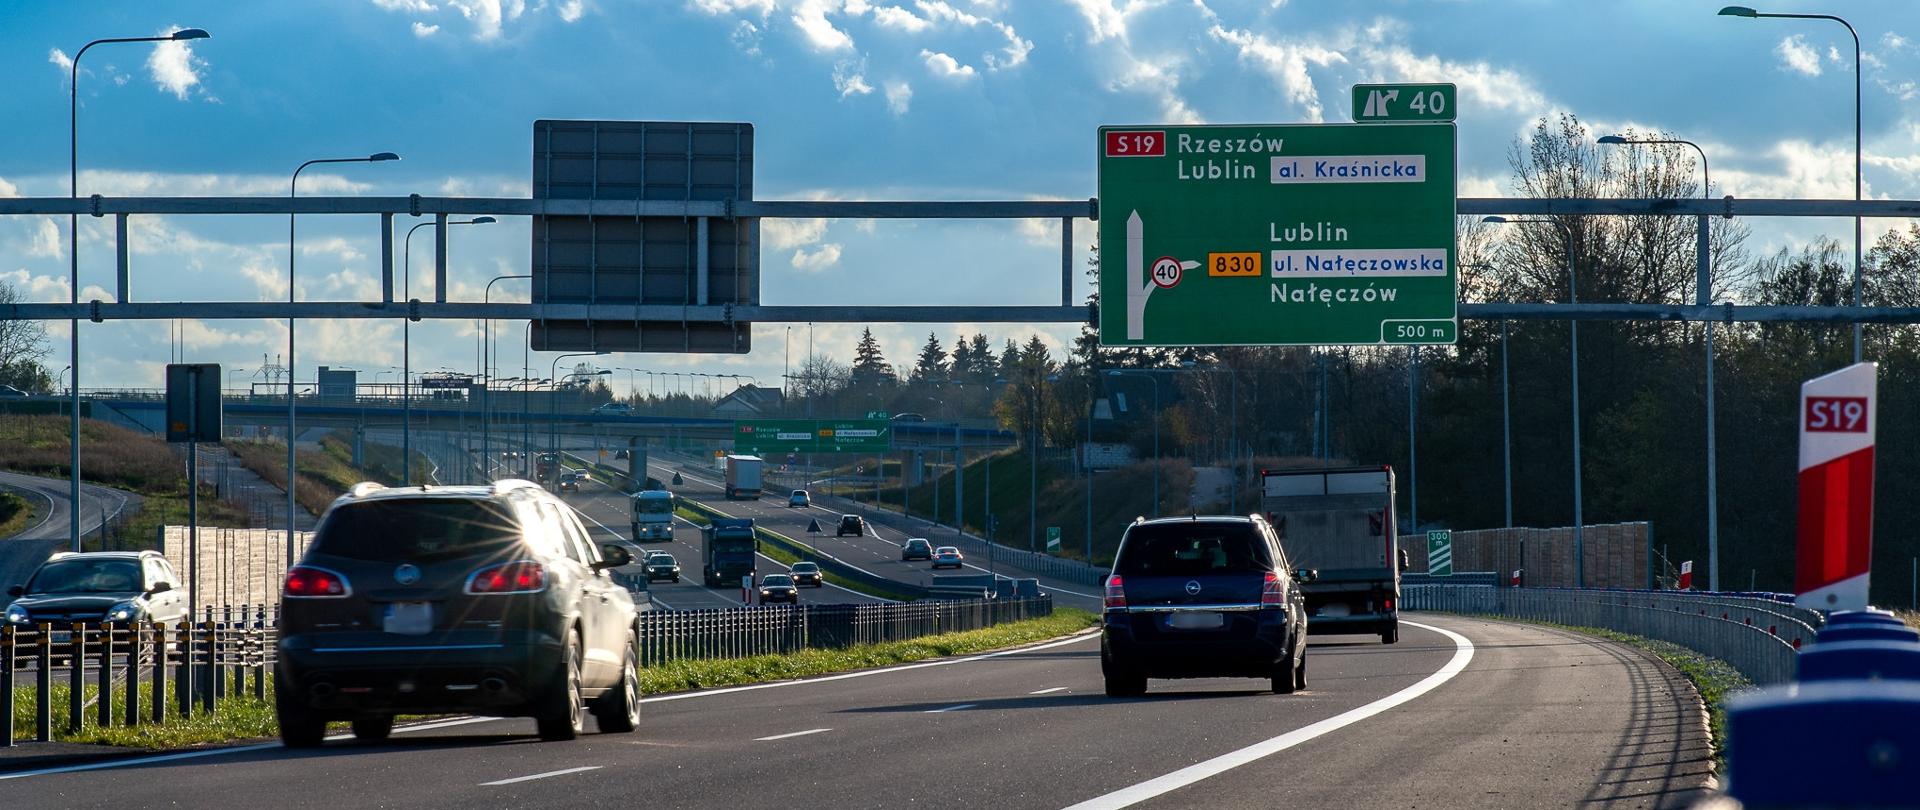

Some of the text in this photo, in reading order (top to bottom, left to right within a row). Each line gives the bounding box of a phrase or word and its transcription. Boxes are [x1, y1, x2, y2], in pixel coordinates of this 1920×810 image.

[1409, 91, 1446, 115] 40
[1178, 133, 1284, 153] Rzeszów
[1178, 160, 1417, 180] Lublin al. Kraśnicka
[1270, 222, 1348, 242] Lublin
[1156, 265, 1178, 280] 40
[1215, 255, 1255, 273] 830
[1274, 254, 1444, 275] ul. Nałęczowska
[1271, 283, 1397, 307] Nałęczów
[1397, 325, 1444, 338] 500 m
[1810, 401, 1863, 429] S19
[1430, 532, 1448, 540] 300
